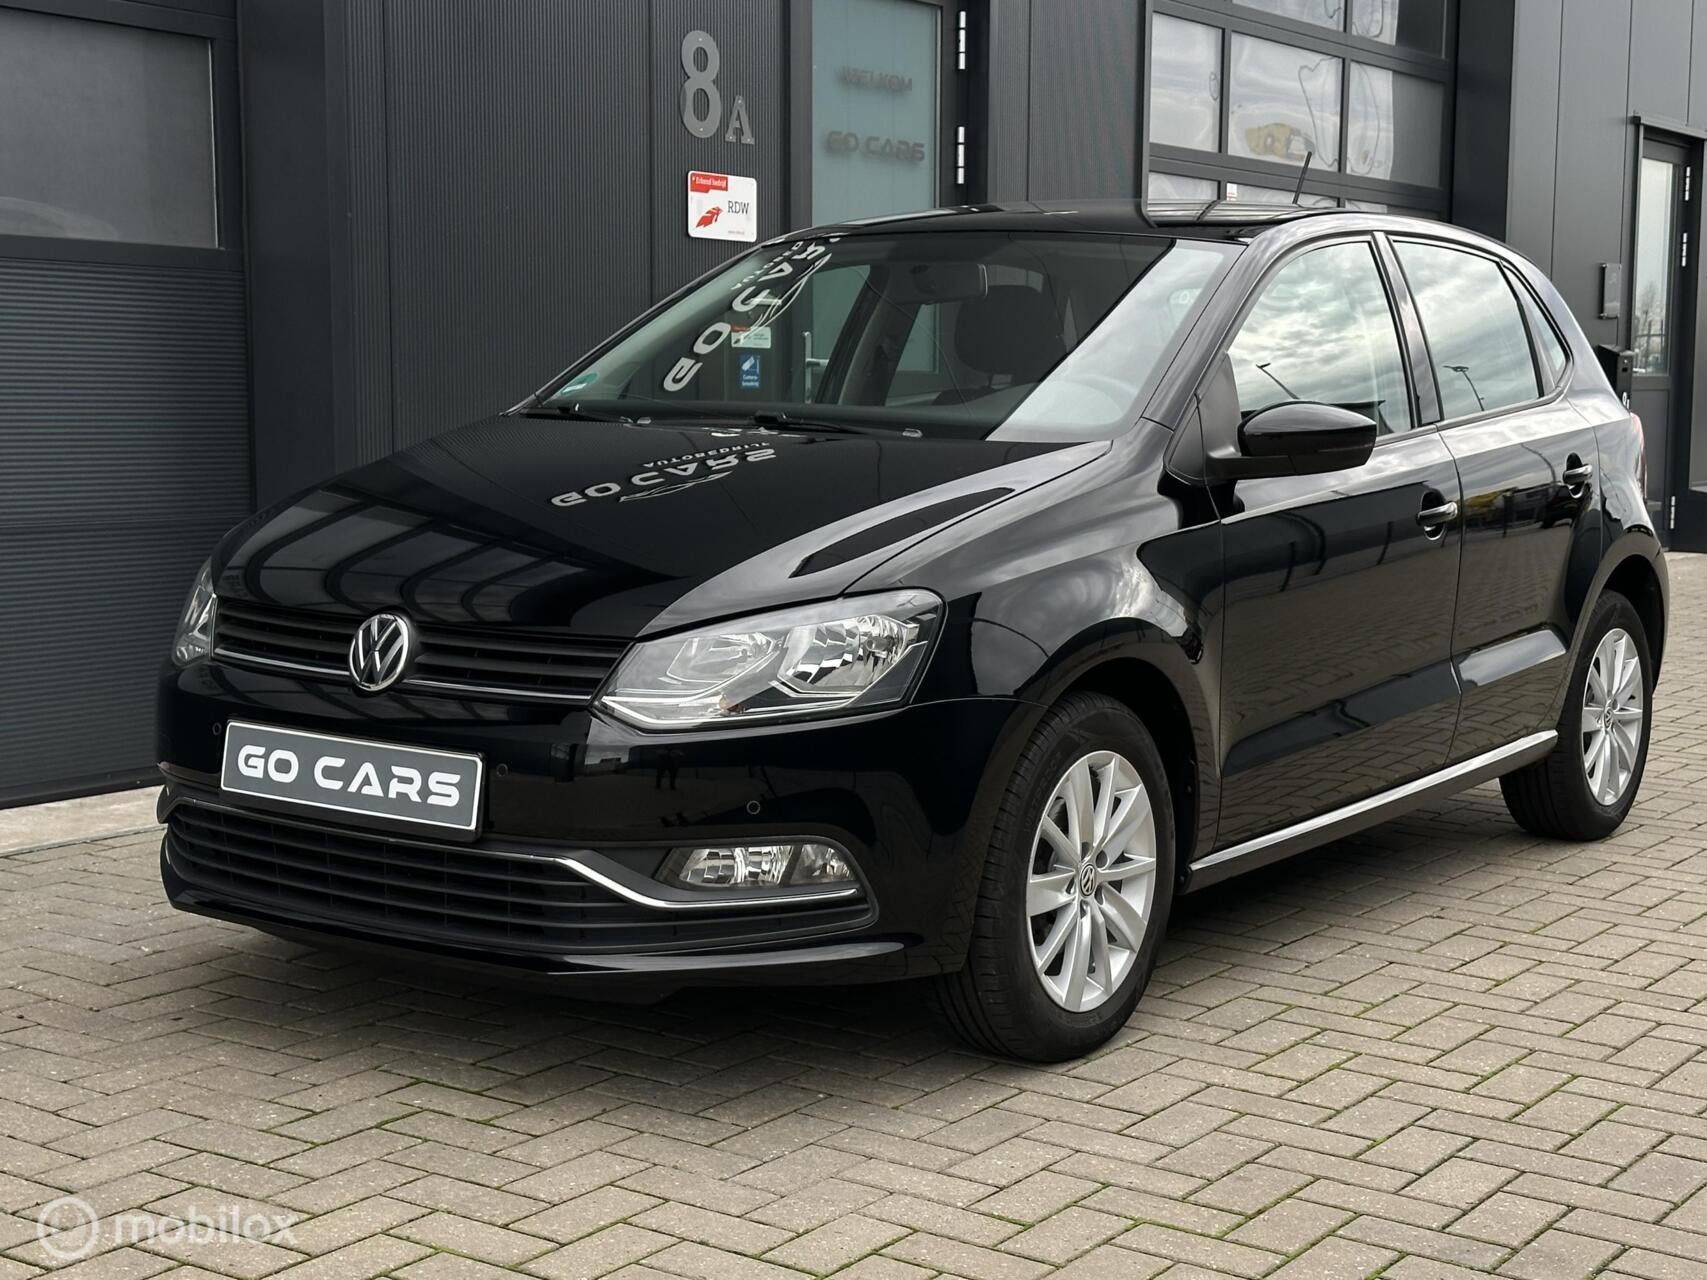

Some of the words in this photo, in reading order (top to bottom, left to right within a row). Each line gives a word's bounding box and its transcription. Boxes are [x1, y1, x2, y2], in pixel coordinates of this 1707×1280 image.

[827, 131, 859, 153] GO
[865, 136, 925, 162] CARS
[728, 200, 749, 214] RDW
[237, 744, 299, 784] GO
[313, 756, 461, 807] CARS
